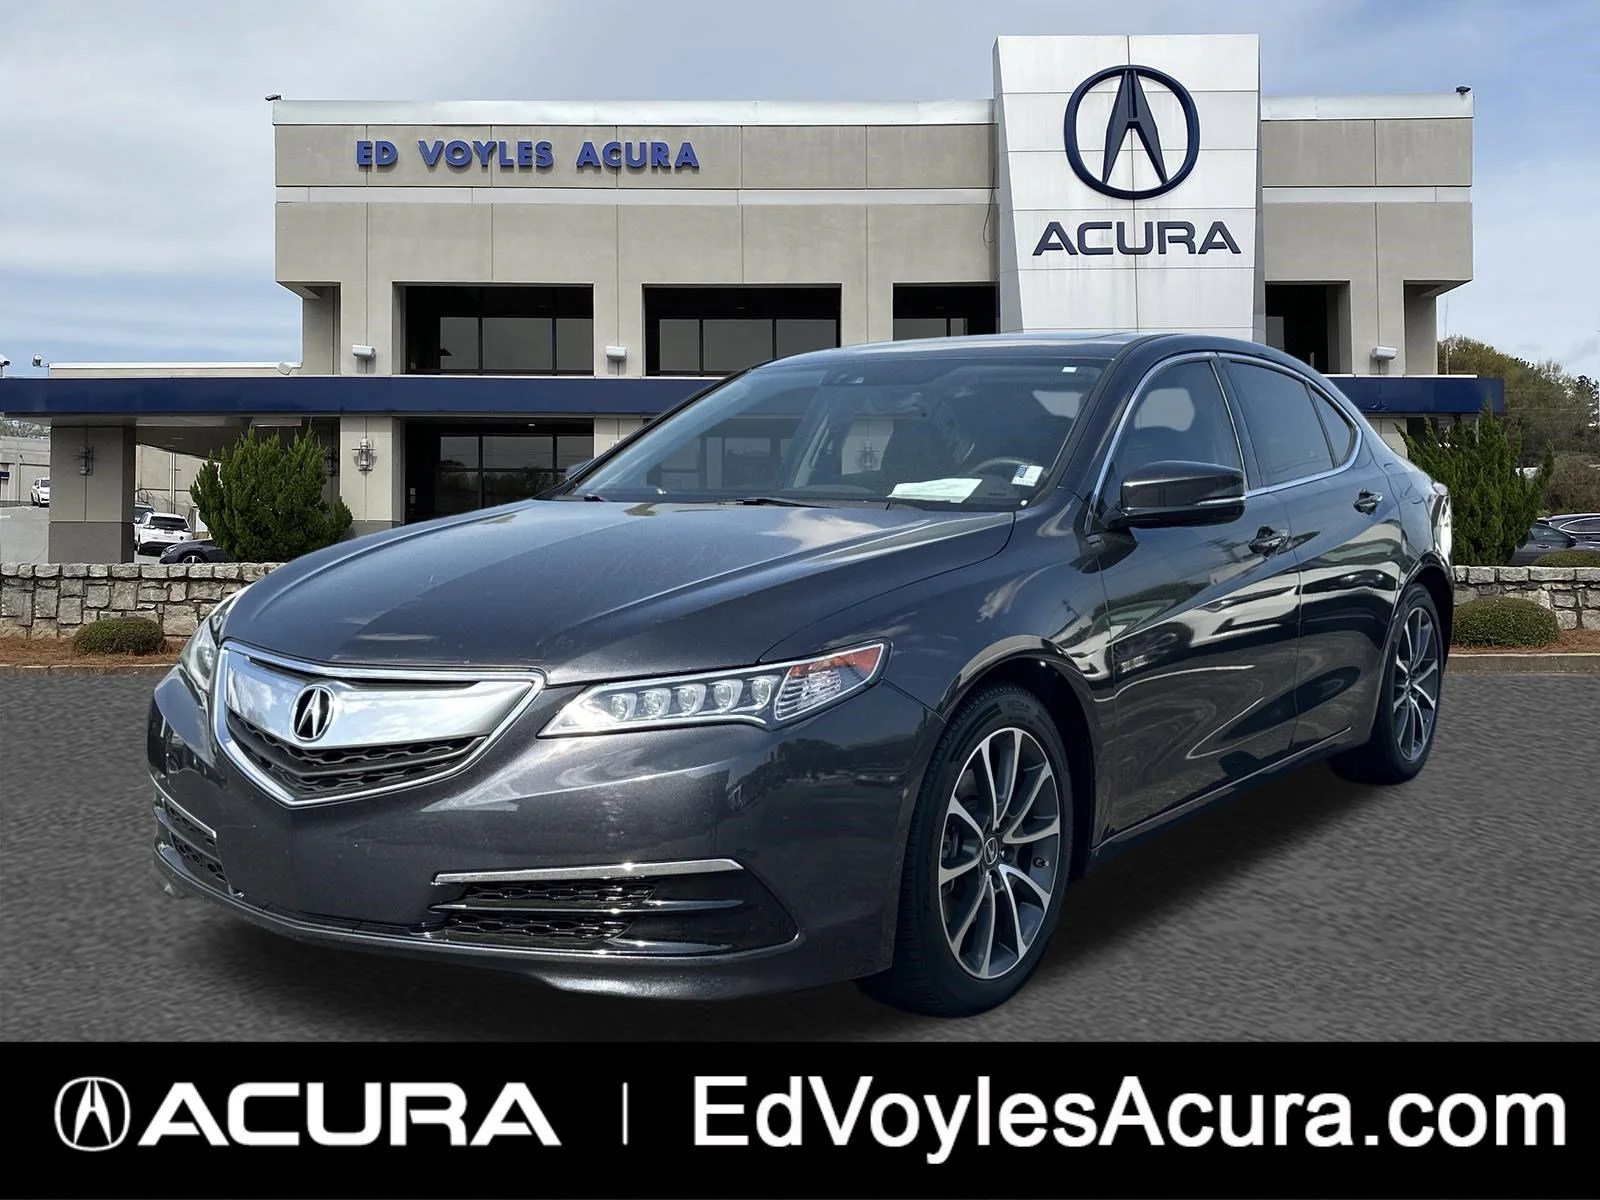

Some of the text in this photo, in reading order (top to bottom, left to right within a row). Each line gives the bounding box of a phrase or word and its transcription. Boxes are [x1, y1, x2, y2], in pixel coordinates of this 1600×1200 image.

[355, 140, 699, 171] ED VOYLES ACURA
[1032, 221, 1242, 256] ACURA
